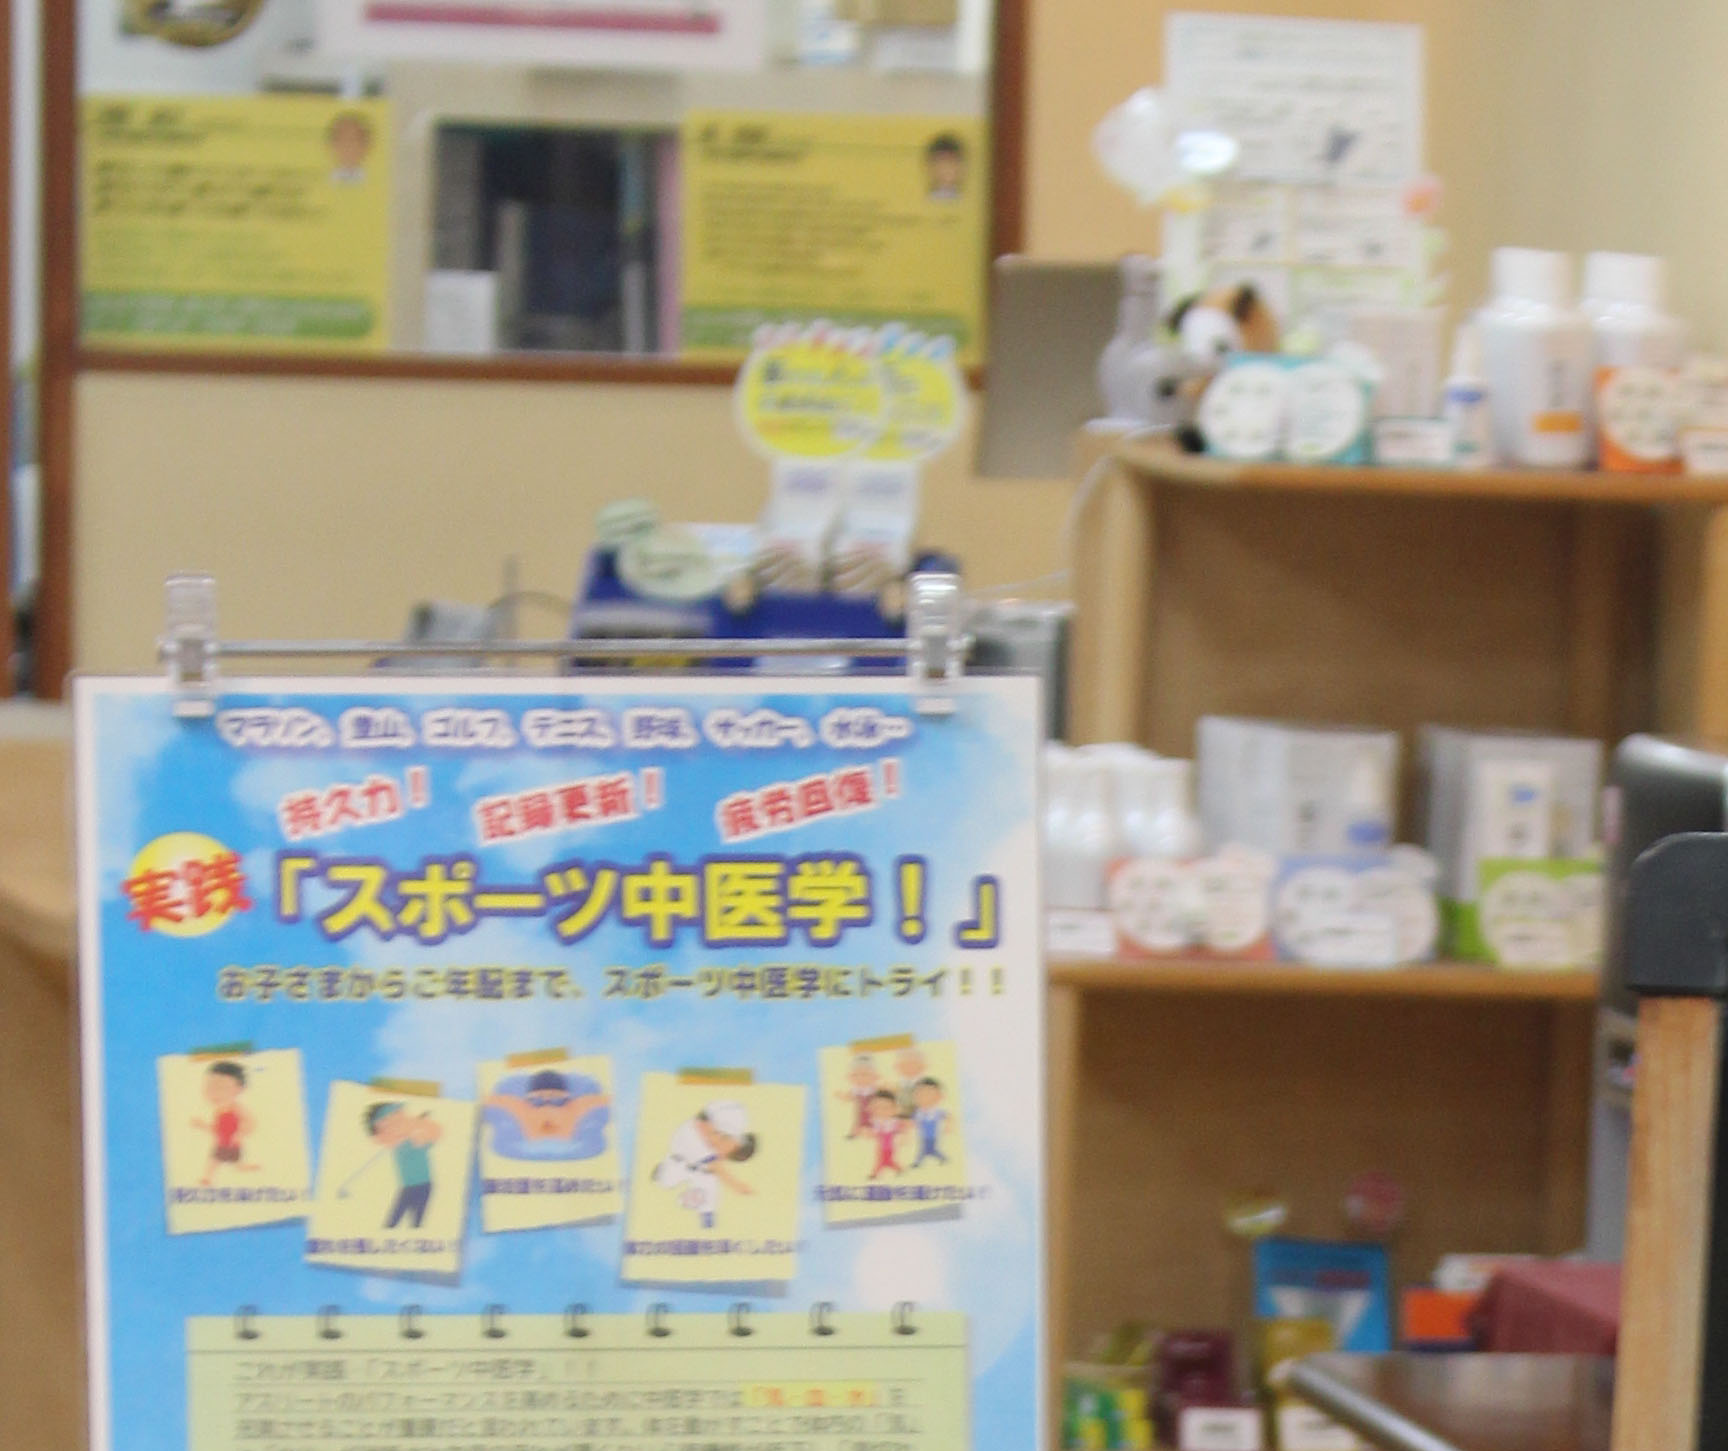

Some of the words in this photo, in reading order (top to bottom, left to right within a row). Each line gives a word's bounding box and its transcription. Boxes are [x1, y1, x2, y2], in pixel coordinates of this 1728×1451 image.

[275, 855, 1001, 944] 「スポーツ中医学！」
